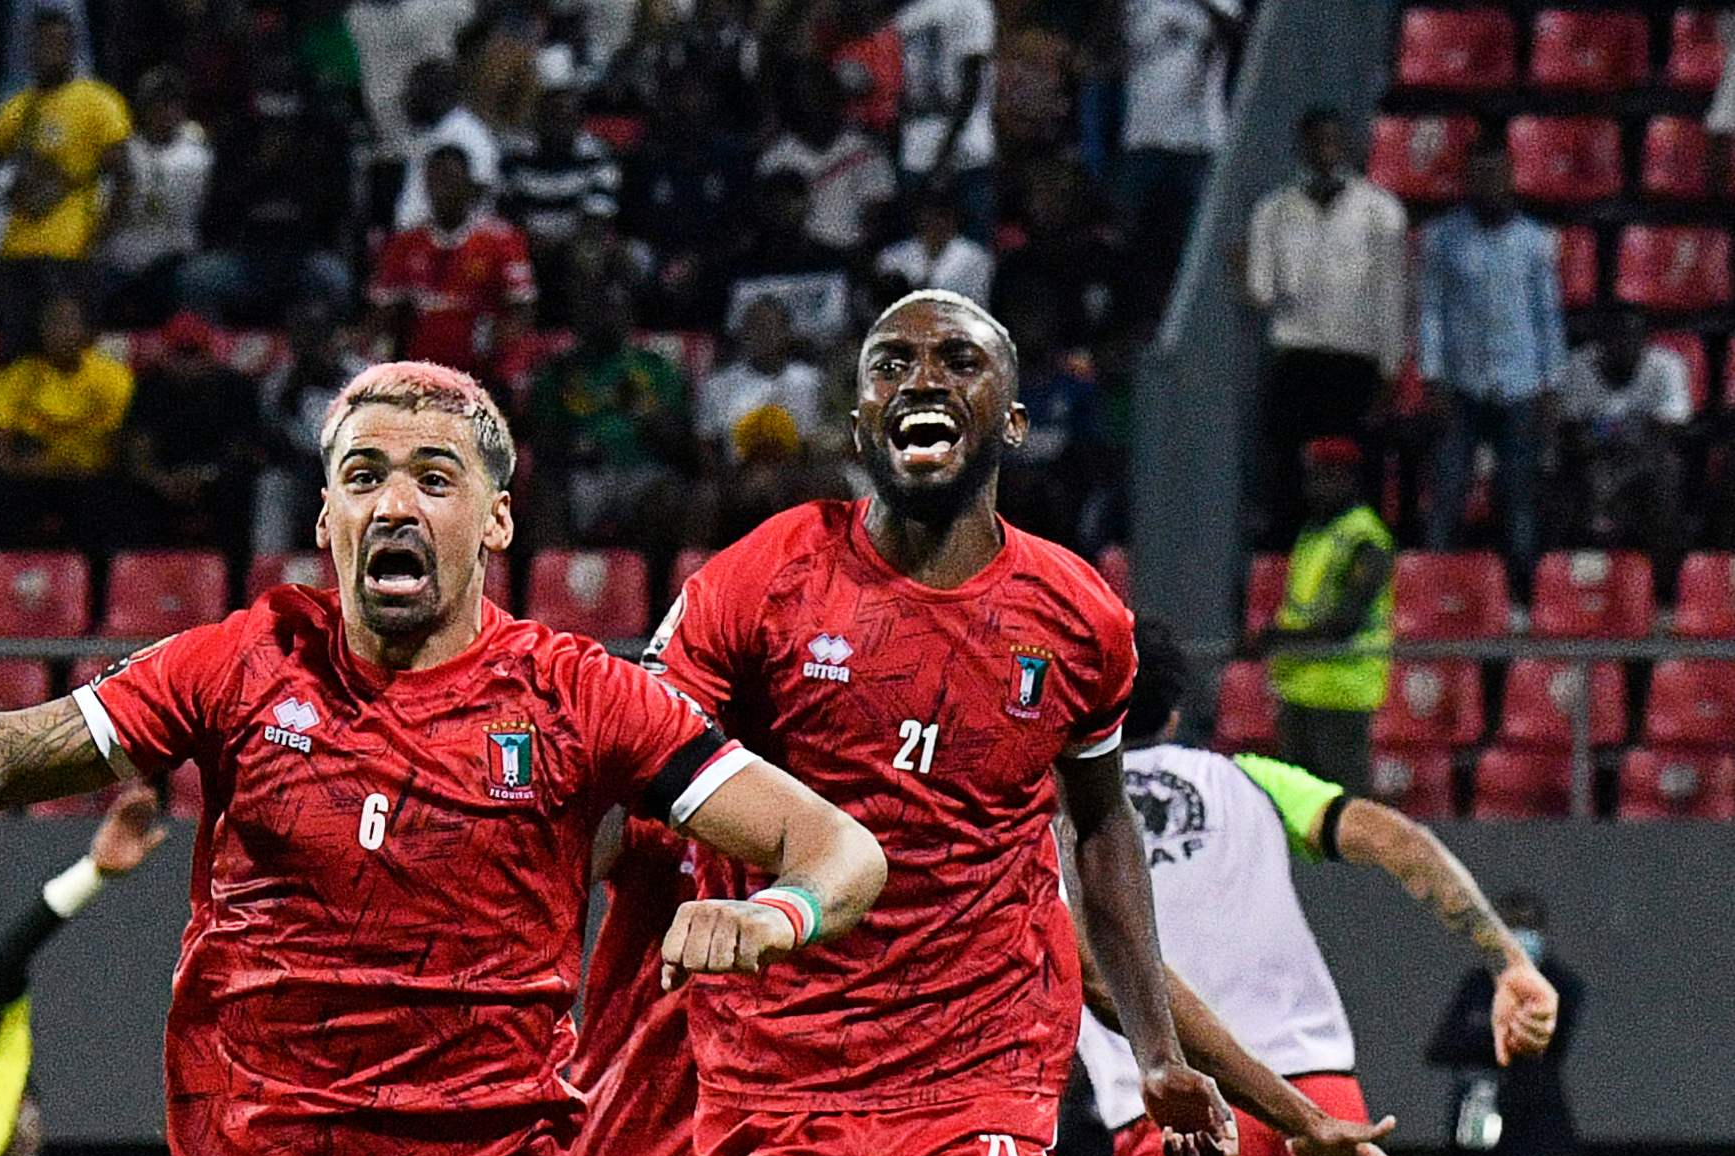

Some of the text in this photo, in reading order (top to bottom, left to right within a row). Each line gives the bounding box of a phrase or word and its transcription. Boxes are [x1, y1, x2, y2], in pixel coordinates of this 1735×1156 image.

[803, 661, 850, 683] errea
[264, 725, 312, 753] errea
[892, 719, 939, 774] 21
[358, 792, 389, 850] 6
[1150, 838, 1204, 868] AF
